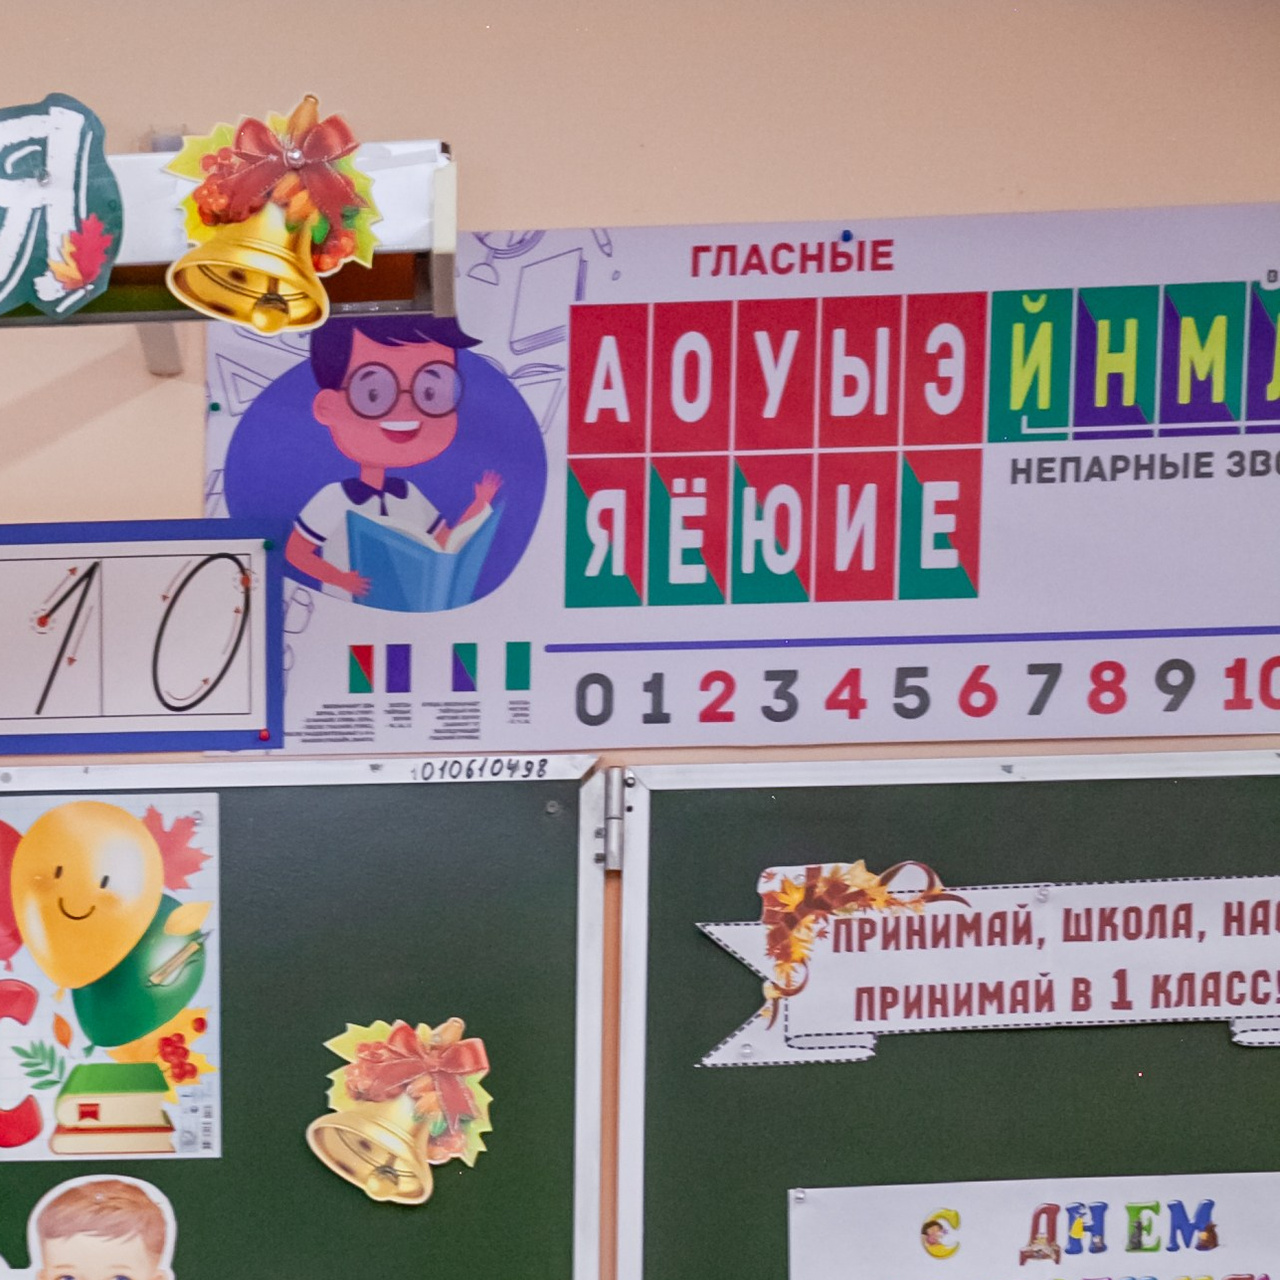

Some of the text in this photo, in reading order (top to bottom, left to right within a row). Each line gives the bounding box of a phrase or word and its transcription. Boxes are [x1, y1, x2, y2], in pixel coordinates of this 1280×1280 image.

[692, 240, 894, 277] ГЛАСНЫЕ
[584, 336, 630, 423] А
[671, 331, 711, 422] О
[754, 330, 799, 418] У
[830, 327, 889, 417] Ы
[924, 323, 966, 415] Э
[1010, 294, 1052, 410] Й
[1094, 318, 1138, 407] Н
[1177, 315, 1227, 404] М
[1011, 450, 1280, 484] НЕПАРНЫЕ ЗВ
[585, 478, 959, 583] Я Ё Ю И Е
[575, 673, 614, 726] 0
[642, 673, 671, 724] 1
[698, 670, 737, 722] 2
[762, 670, 798, 722] 3
[824, 668, 867, 719] 4
[893, 667, 931, 719] 5
[958, 665, 998, 717] 6
[1027, 663, 1062, 715] 7
[1087, 661, 1127, 714] 8
[1154, 658, 1195, 711] 9
[832, 900, 1280, 953] ПРИНИМАЙ, ШКОЛА, НА
[854, 971, 1055, 1022] ПРИНИМАЙ
[1071, 977, 1093, 1012] В
[1110, 969, 1133, 1011] 1
[921, 1198, 1220, 1266] С ДНЕМ
